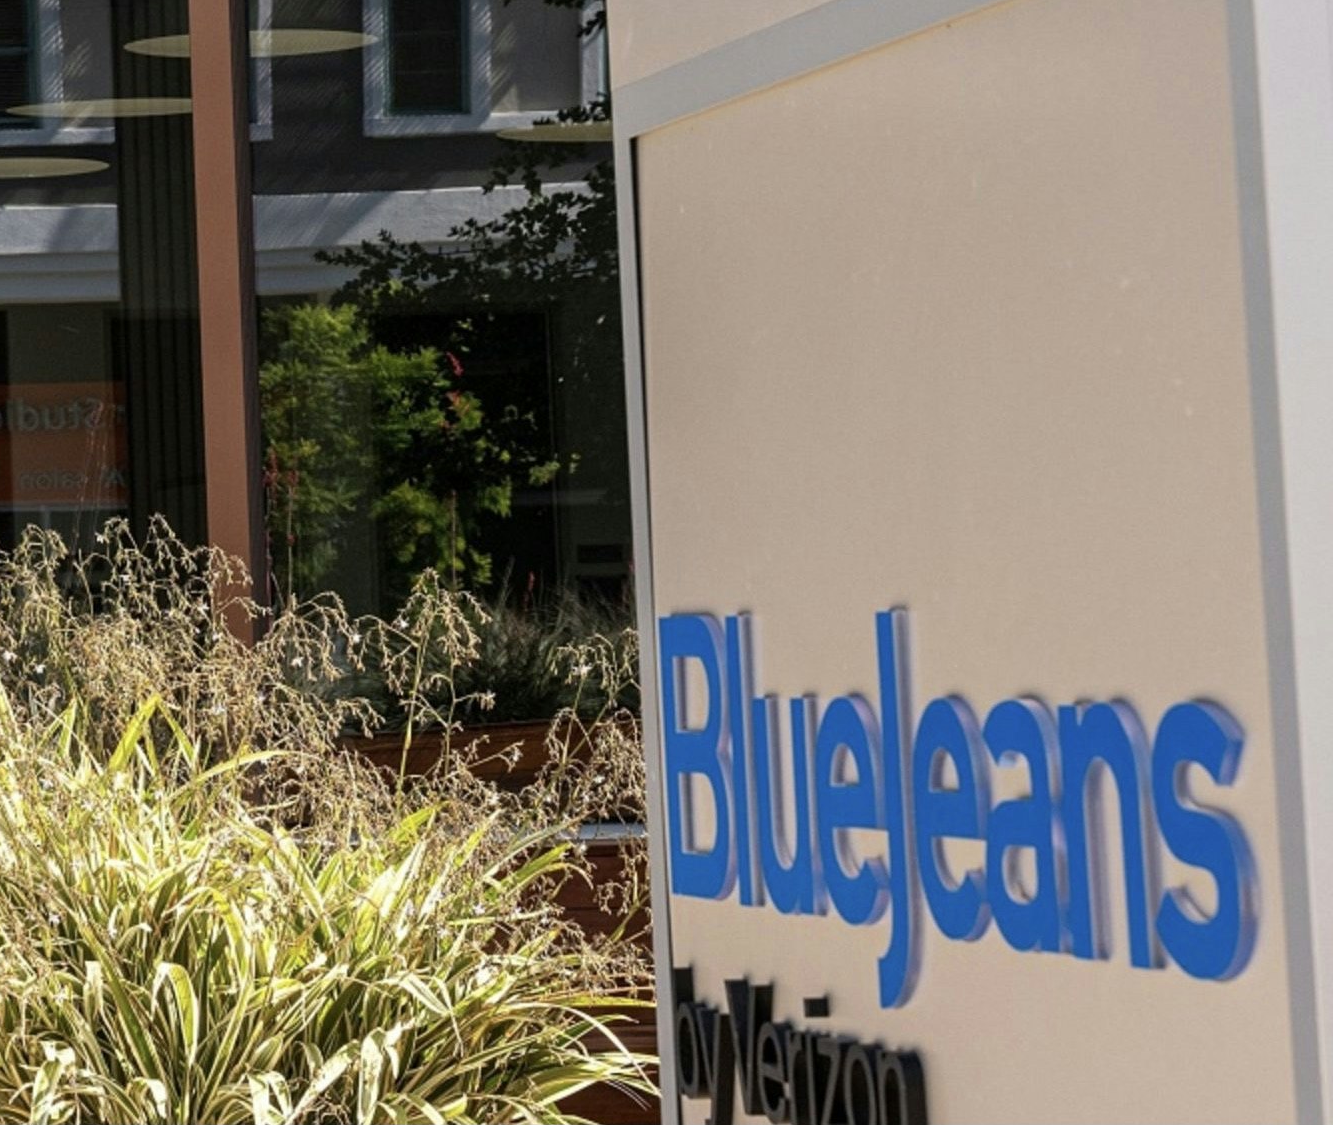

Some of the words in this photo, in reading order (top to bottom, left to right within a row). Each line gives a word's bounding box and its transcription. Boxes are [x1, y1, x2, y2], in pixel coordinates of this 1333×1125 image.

[659, 606, 1262, 1008] BlueJeans
[673, 962, 734, 1125] by
[724, 974, 930, 1125] Verizon
